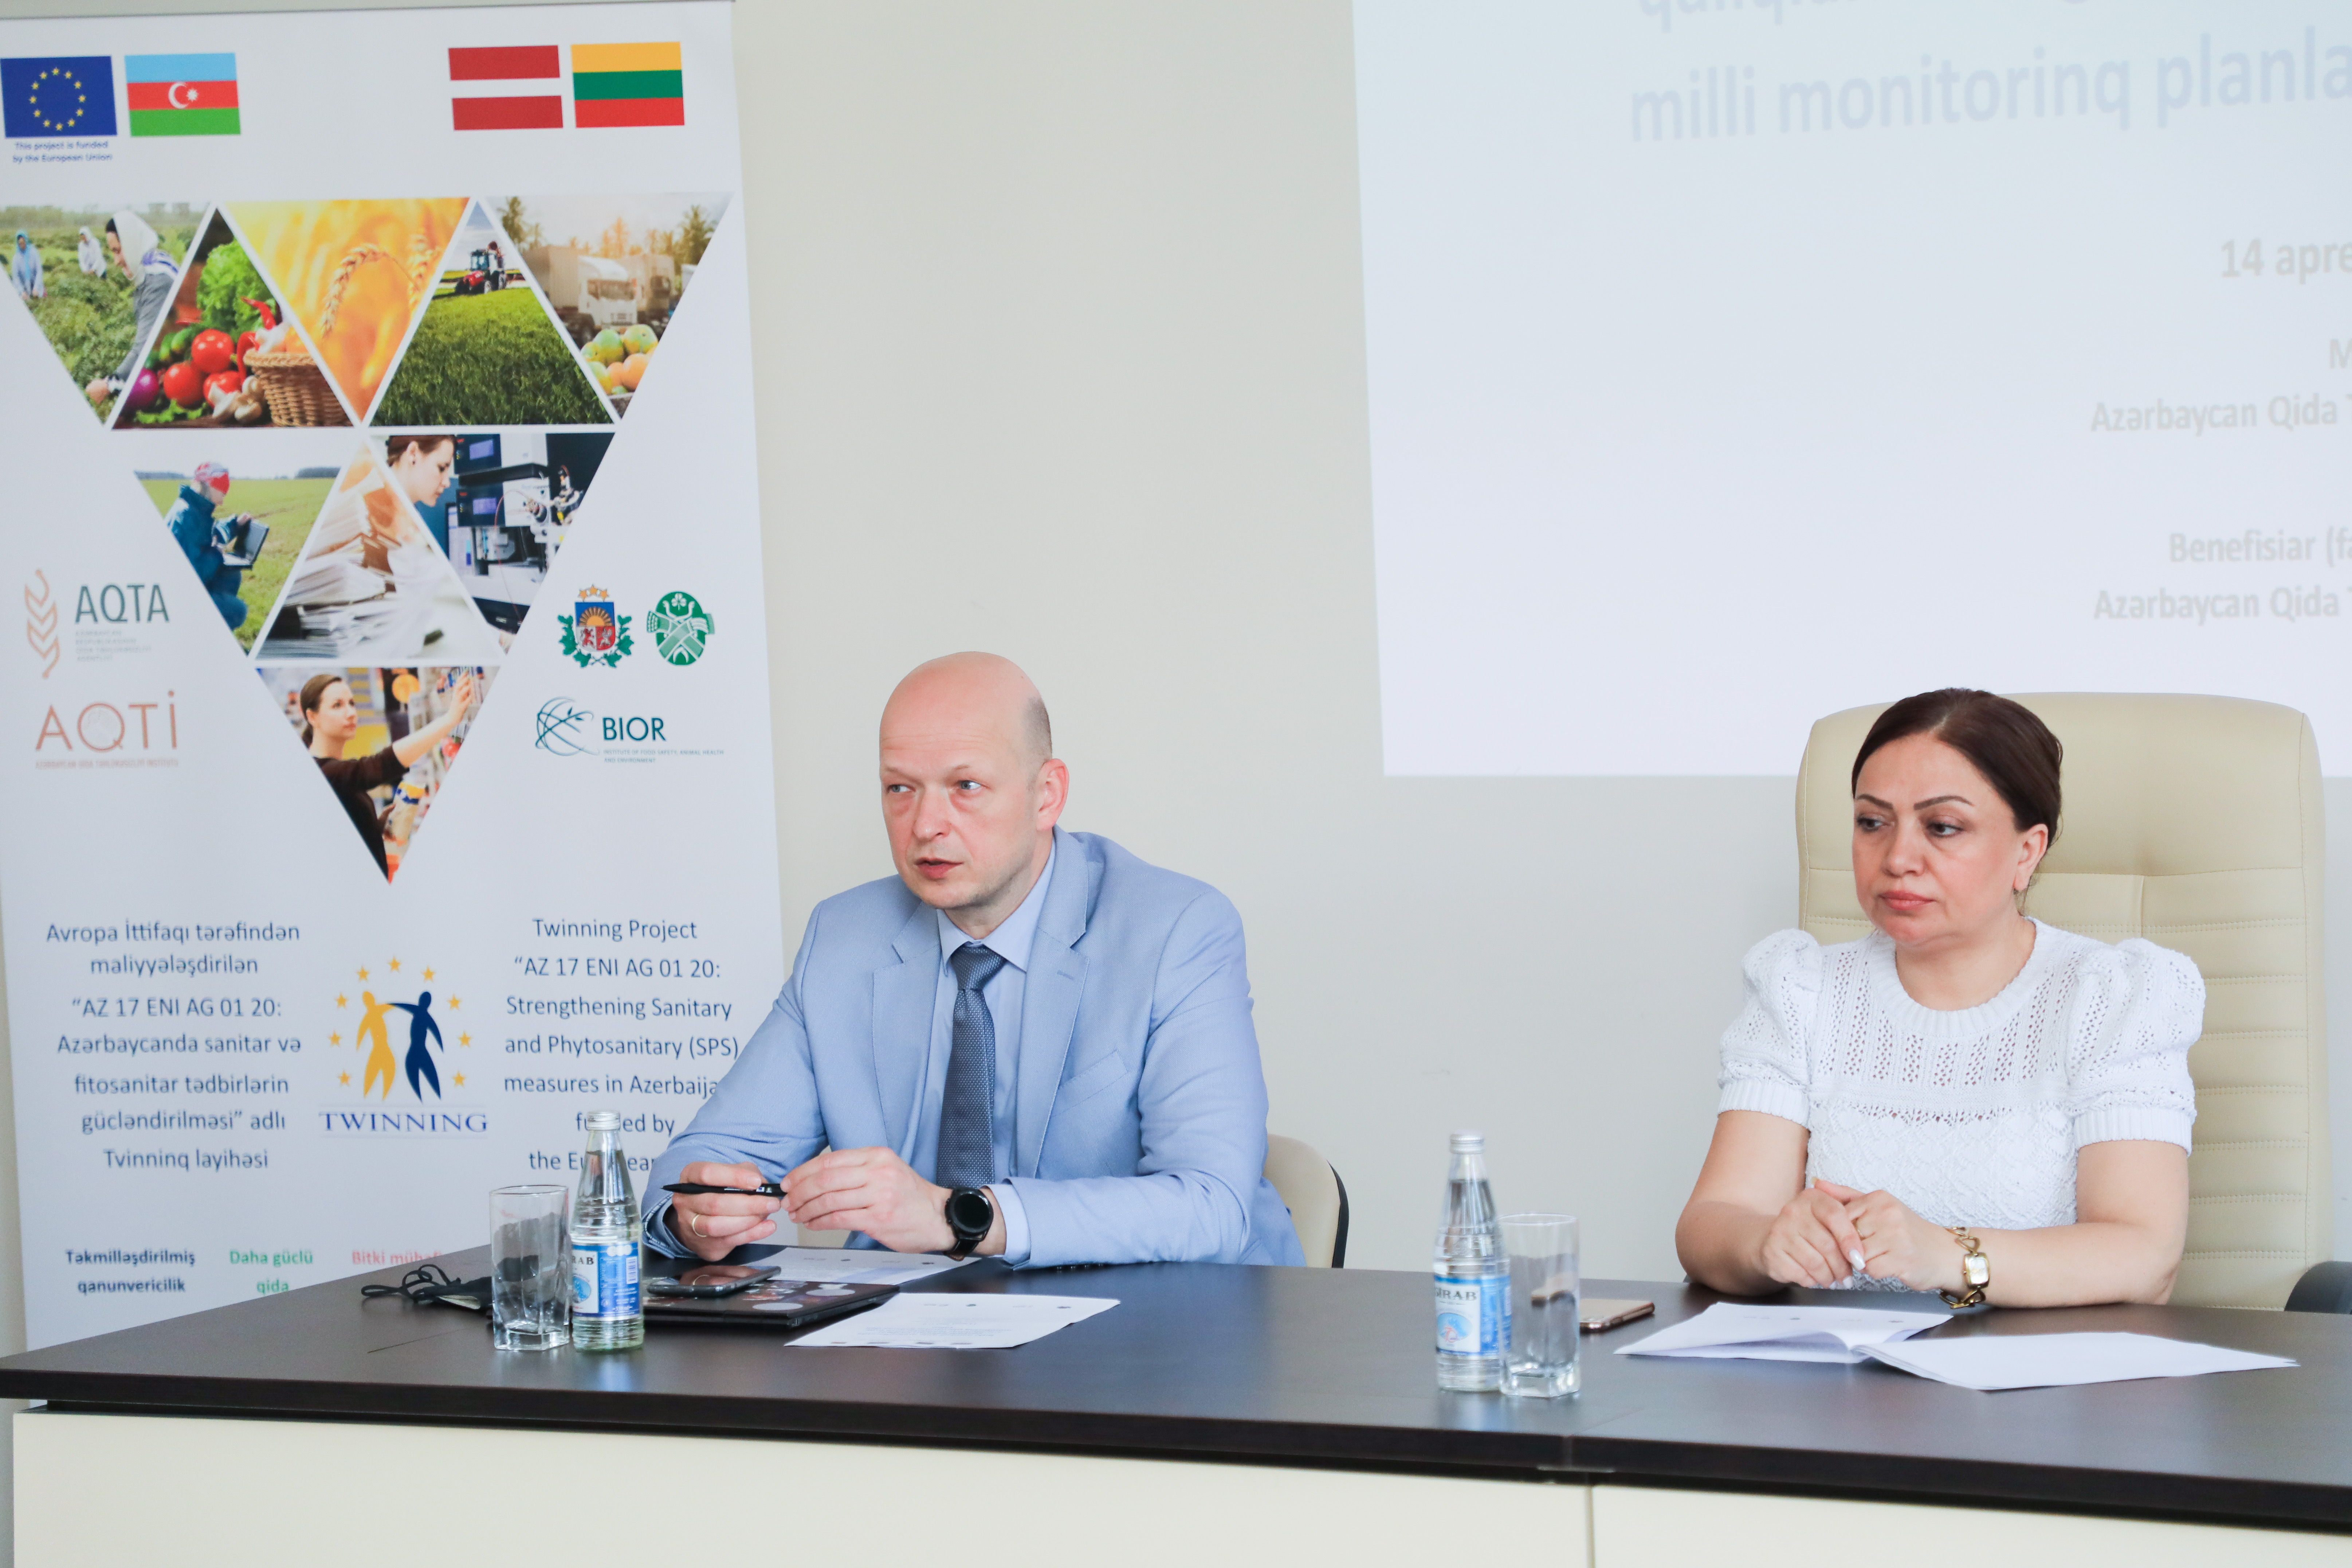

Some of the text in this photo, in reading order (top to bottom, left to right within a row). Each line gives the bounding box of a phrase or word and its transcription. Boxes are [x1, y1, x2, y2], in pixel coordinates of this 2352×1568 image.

[1632, 65, 1755, 141] milli
[1779, 46, 2131, 133] monitorinq
[34, 142, 64, 150] project
[12, 156, 23, 164] by
[41, 154, 83, 162] European
[85, 153, 113, 161] Union
[2222, 238, 2264, 277] 14
[2091, 398, 2257, 436] Azərbaycan
[2268, 393, 2337, 431] Qida
[2170, 529, 2316, 562] Benefisiar
[75, 584, 169, 623] AQTA
[2094, 587, 2259, 625] Azərbaycan
[2270, 585, 2339, 622] Qida
[602, 717, 665, 741] BIOR
[47, 924, 118, 945] Avropa
[196, 922, 299, 941] tərəfindən
[533, 919, 696, 943] Twinning Project
[557, 958, 578, 976] 17
[586, 958, 618, 976] ENI
[626, 959, 653, 977] AG
[659, 959, 682, 977] 01
[691, 960, 719, 978] 20:
[117, 998, 139, 1017] 17
[147, 998, 179, 1016] ENI
[187, 998, 213, 1016] AG
[220, 999, 242, 1016] 01
[252, 999, 280, 1016] 20:
[507, 996, 732, 1021] Strengthening Sanitary
[58, 1034, 301, 1056] Azərbaycanda sanitar və
[506, 1035, 738, 1060] and Phytosanitary (SPS)
[75, 1075, 288, 1093] fitosanitar tədbirlərin
[504, 1078, 599, 1092] measures
[606, 1075, 623, 1092] in
[251, 1111, 285, 1129] adlı
[318, 1112, 487, 1132] TWINNING
[653, 1114, 675, 1137] by
[104, 1149, 268, 1172] Tvinninq layihəsi
[529, 1151, 561, 1170] the
[66, 1250, 195, 1266] Təkmilləşdirilmiş
[229, 1250, 313, 1267] Daha güclü
[352, 1251, 385, 1264] Bitki
[78, 1278, 185, 1295] qanunvericilik
[257, 1280, 290, 1294] qida
